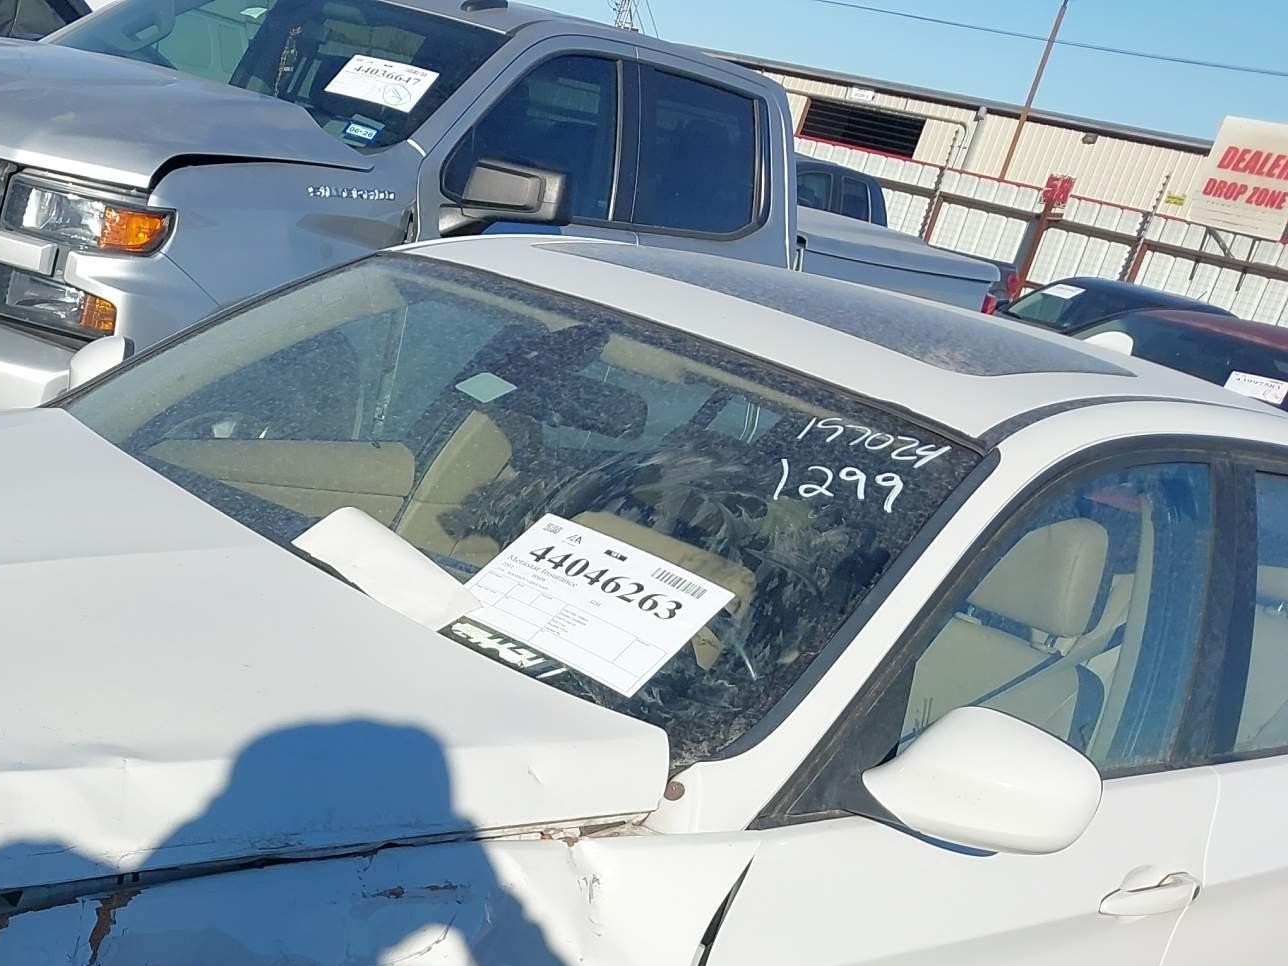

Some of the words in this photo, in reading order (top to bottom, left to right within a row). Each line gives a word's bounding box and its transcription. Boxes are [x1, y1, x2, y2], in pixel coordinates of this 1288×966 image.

[1202, 178, 1249, 201] DROP
[1244, 186, 1288, 211] ZONE
[773, 458, 904, 513] 1299
[529, 545, 683, 620] 44046263
